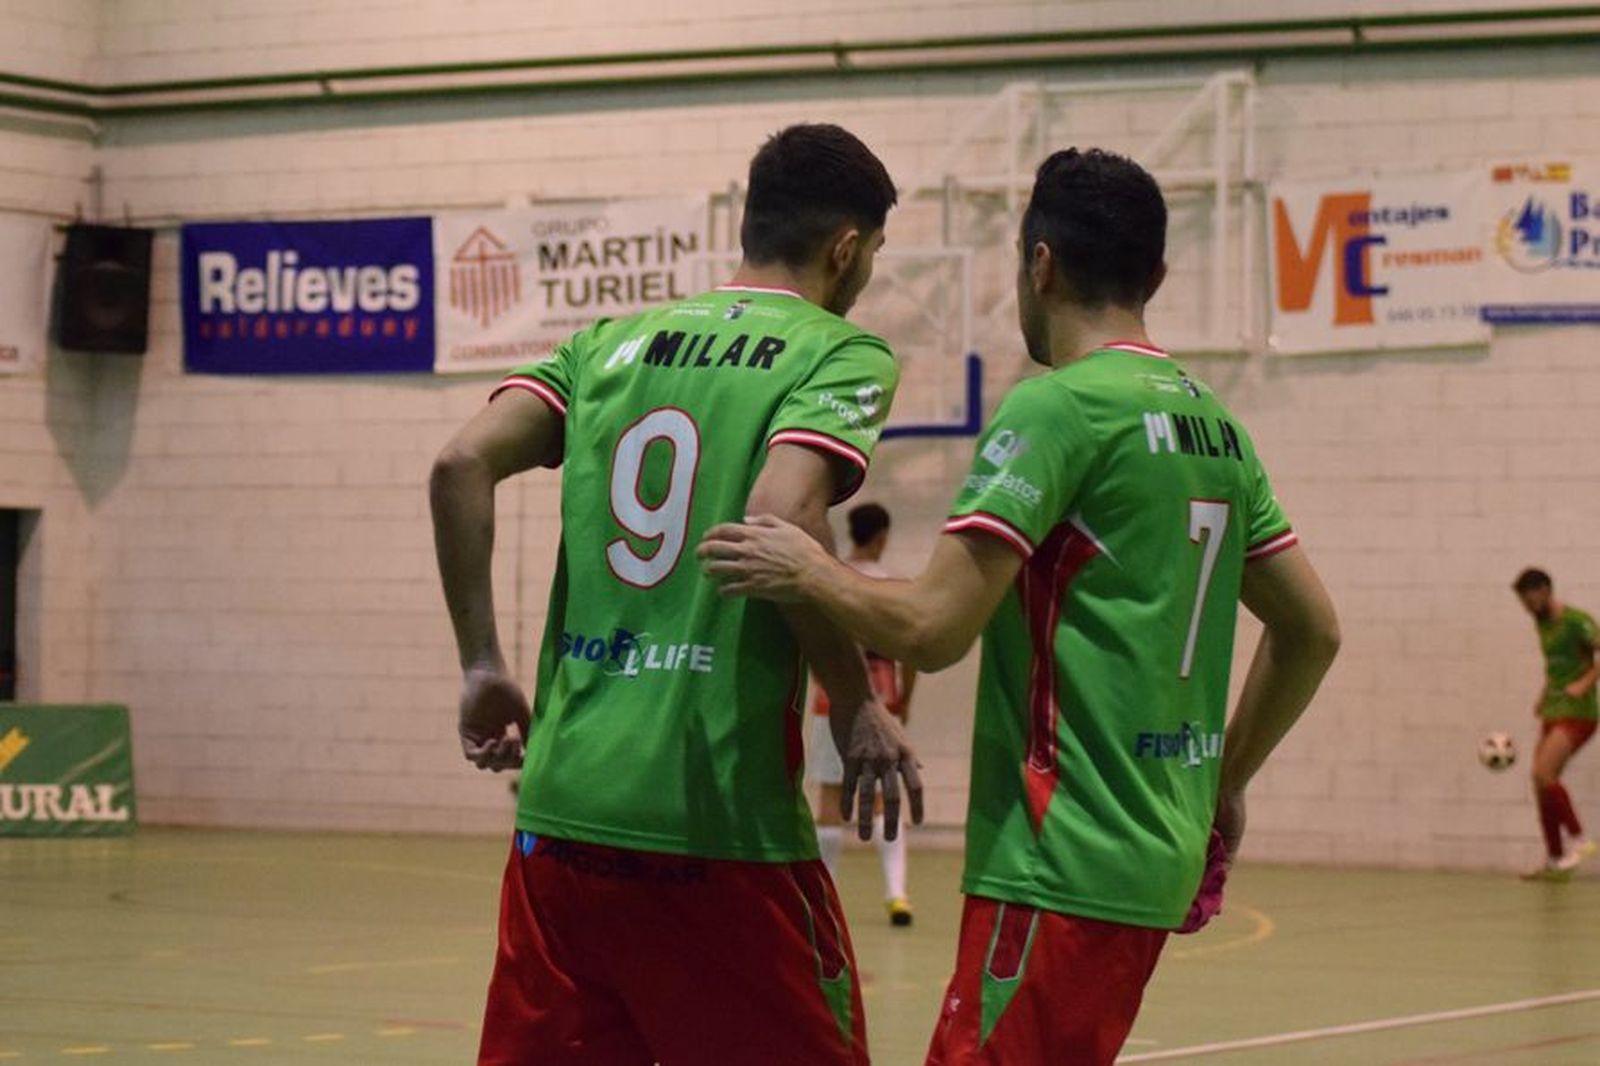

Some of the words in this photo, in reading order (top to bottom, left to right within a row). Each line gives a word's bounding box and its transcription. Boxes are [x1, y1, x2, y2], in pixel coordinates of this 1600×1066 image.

[199, 250, 420, 314] Relieves
[539, 271, 686, 308] TURIEL
[606, 406, 702, 589] 9
[1179, 497, 1231, 681] 7
[0, 784, 129, 821] URAL
